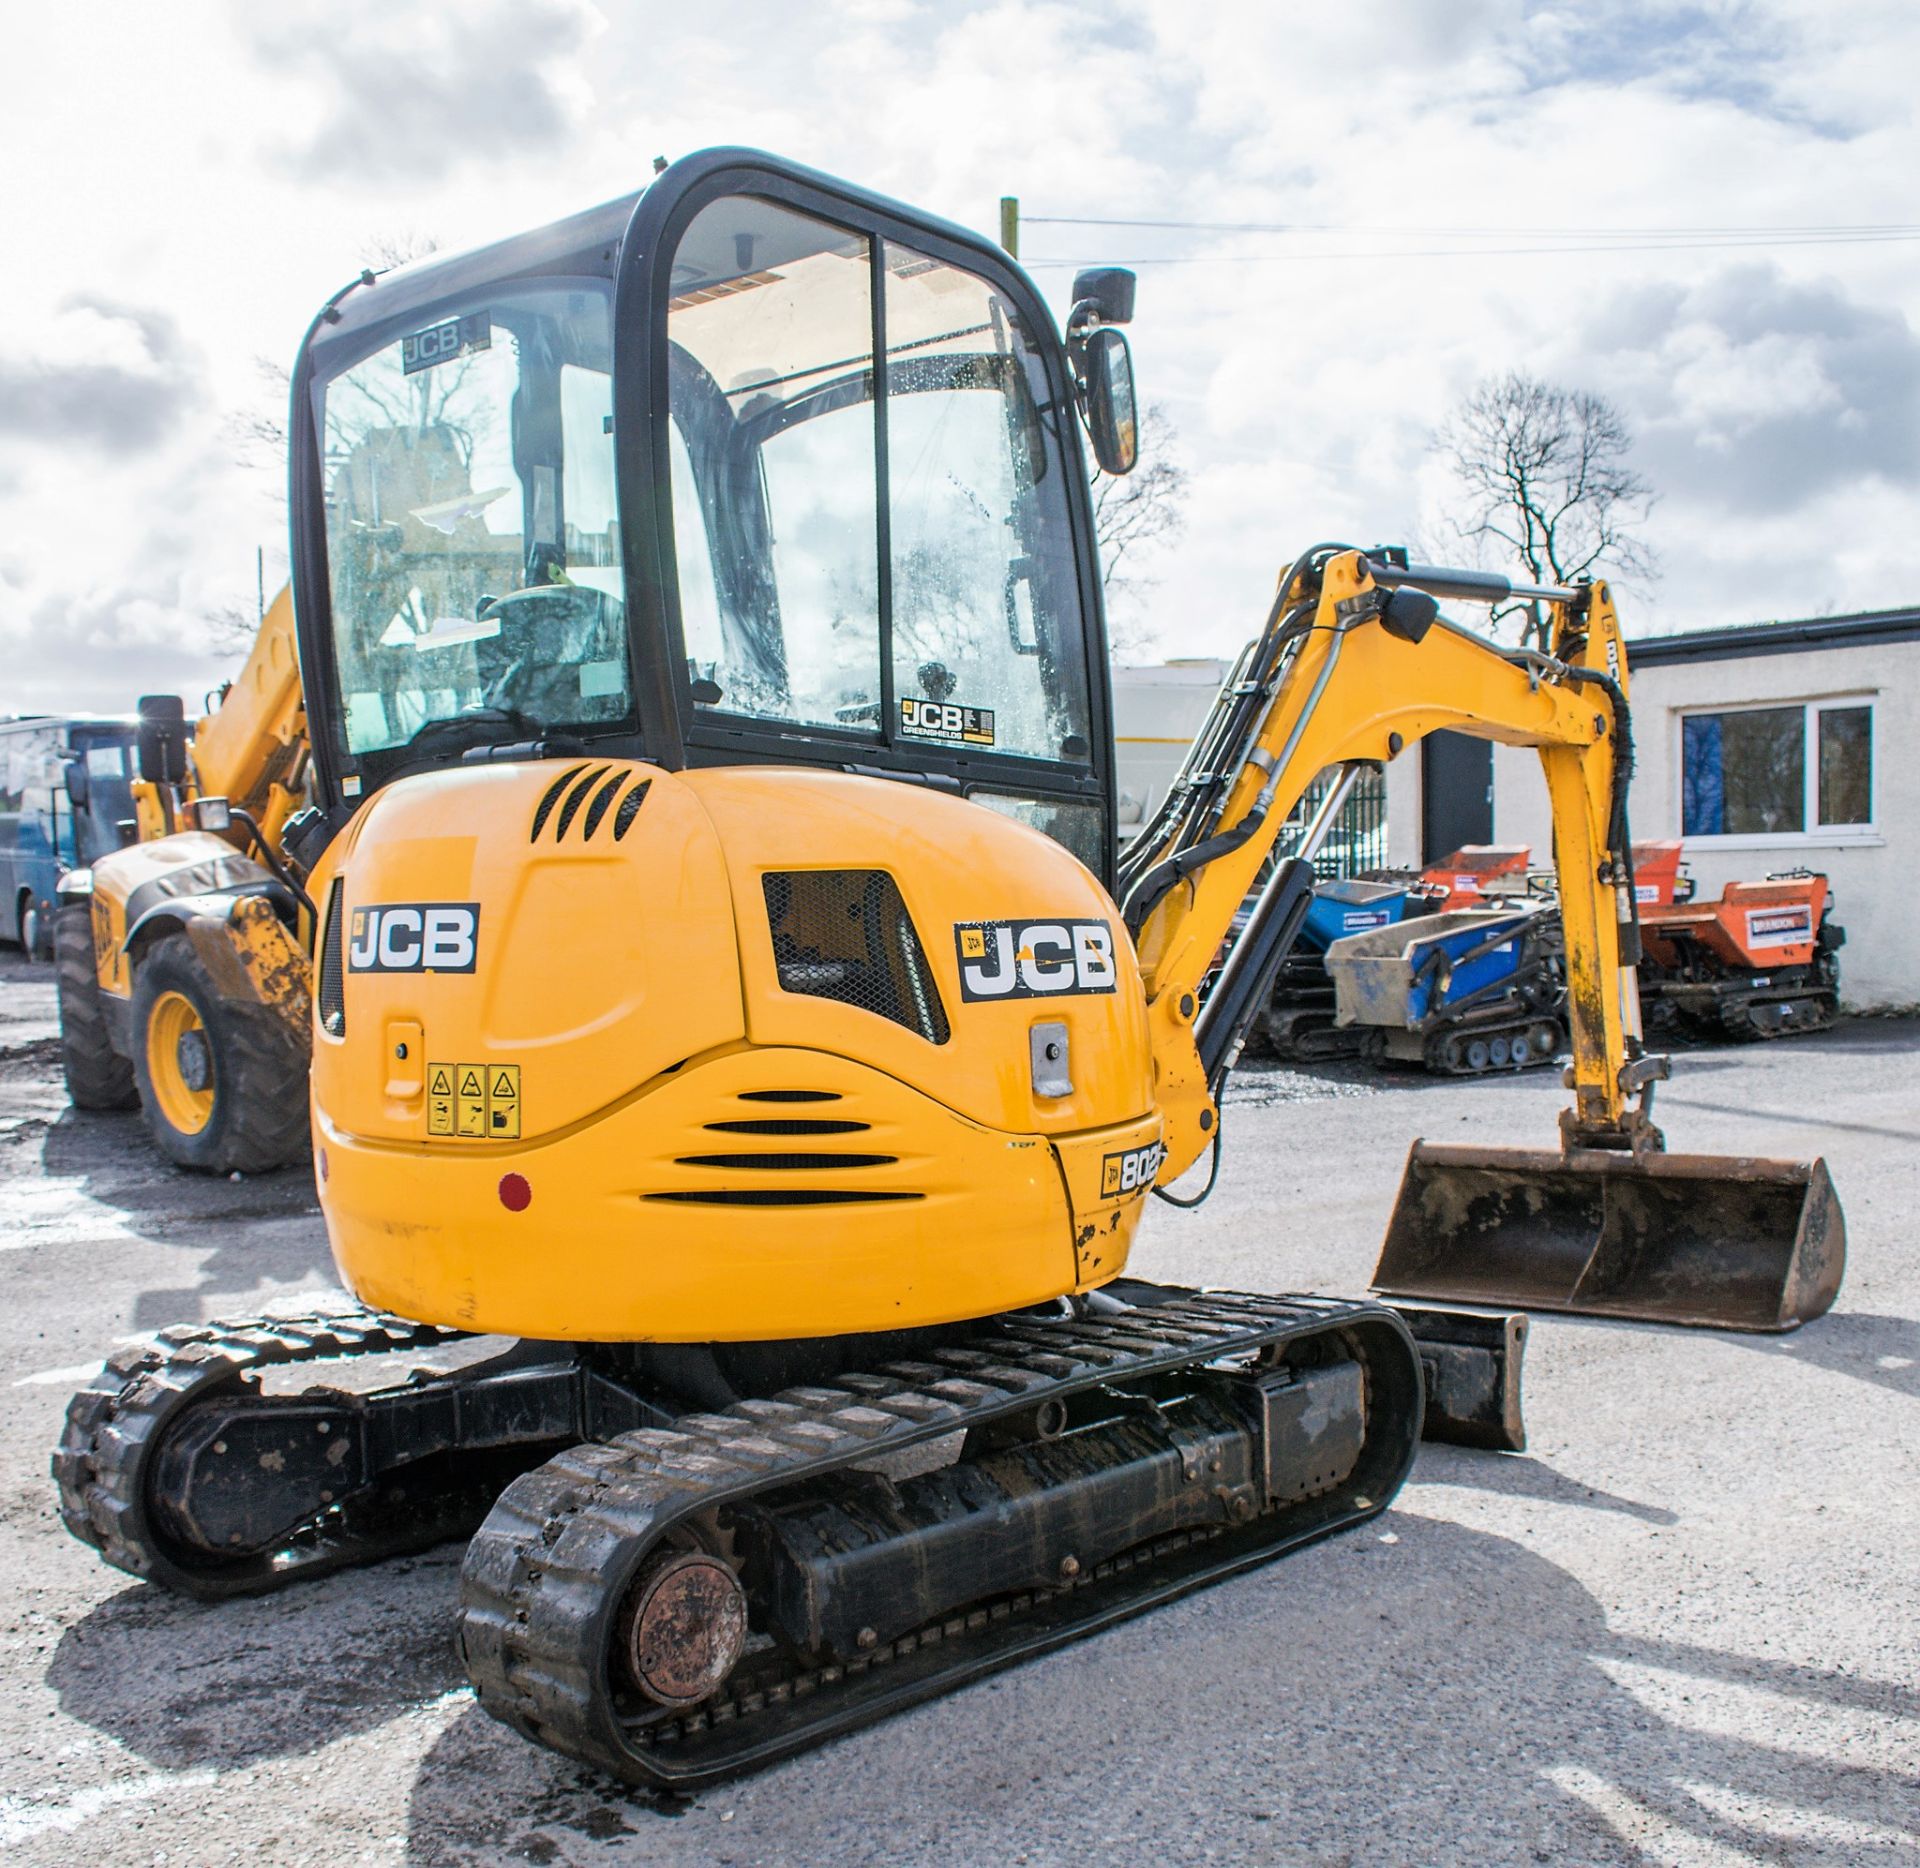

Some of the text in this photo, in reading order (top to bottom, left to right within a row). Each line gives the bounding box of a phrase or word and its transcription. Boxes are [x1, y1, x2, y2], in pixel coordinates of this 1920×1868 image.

[405, 325, 459, 364] JCB
[902, 701, 963, 732] JCB
[902, 726, 963, 740] GREENSHIELDS
[351, 909, 474, 968] JCB
[964, 926, 1115, 995] JCB
